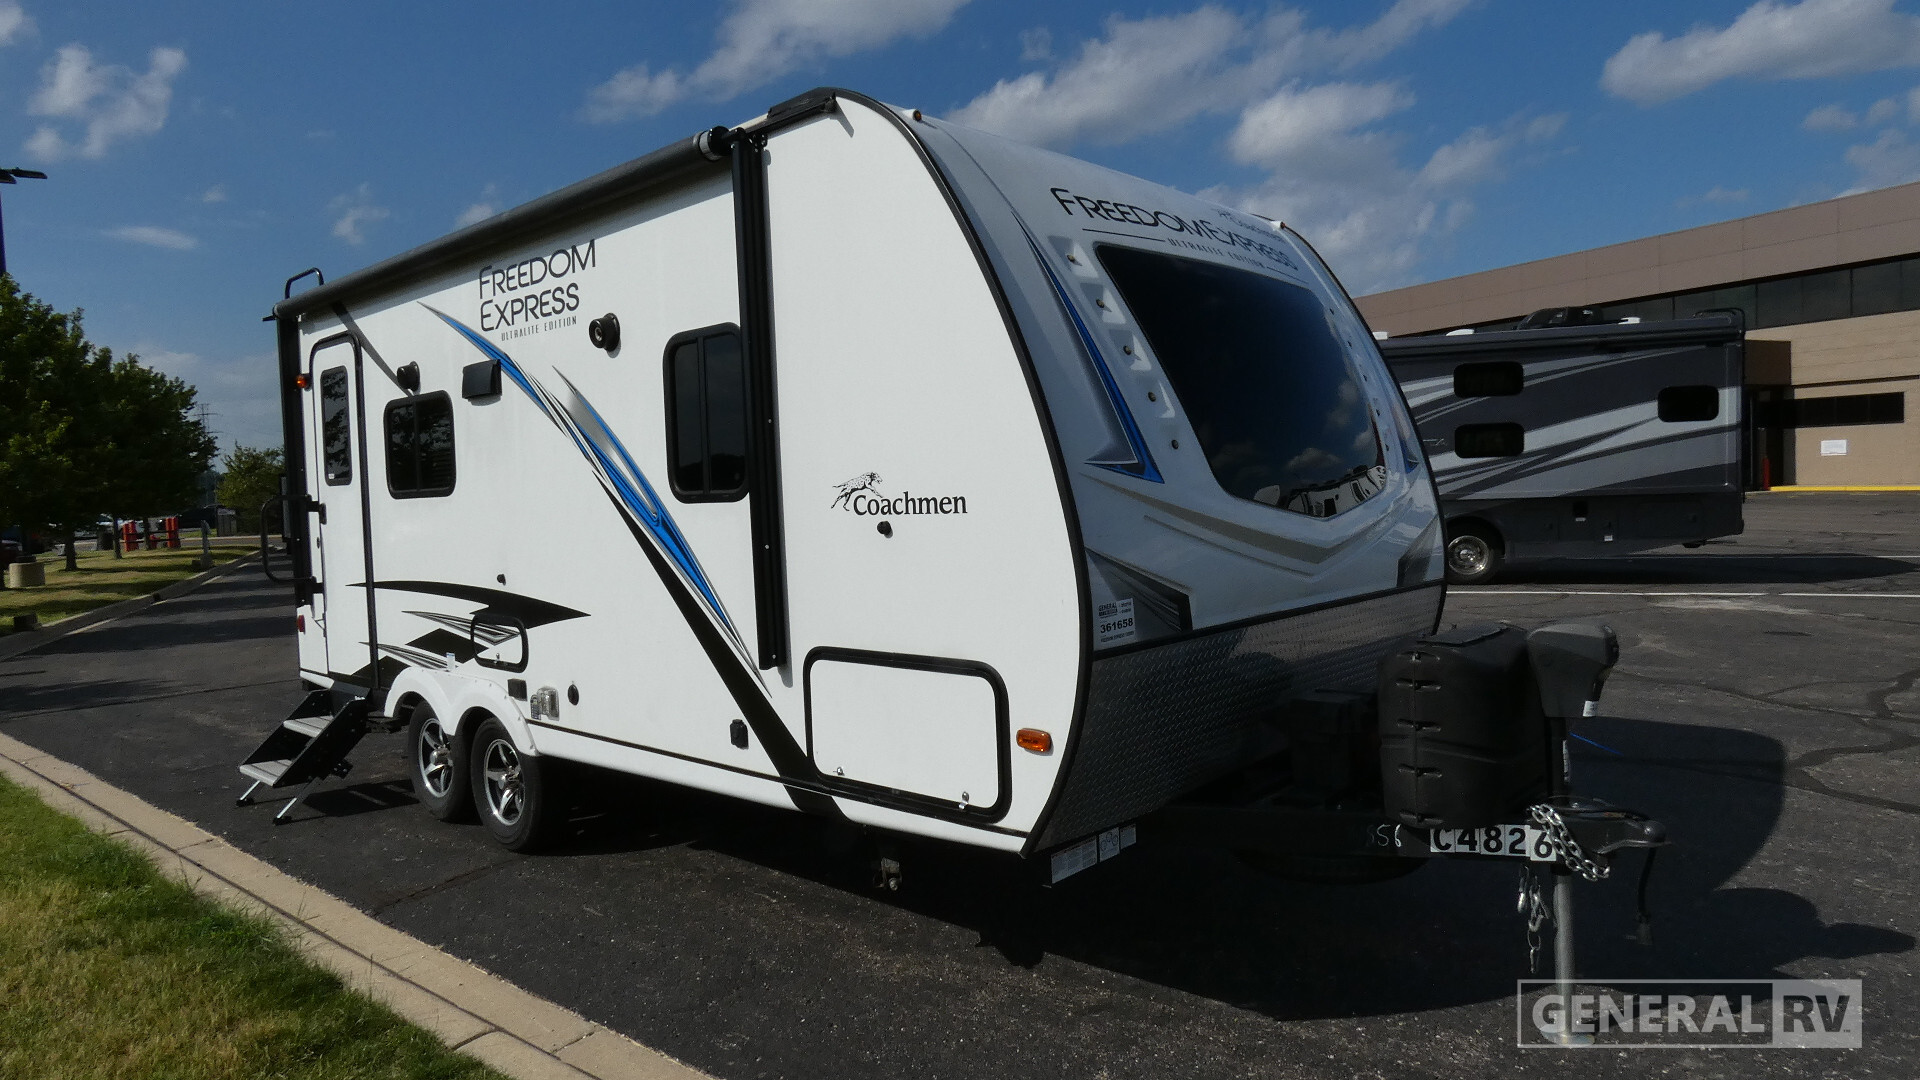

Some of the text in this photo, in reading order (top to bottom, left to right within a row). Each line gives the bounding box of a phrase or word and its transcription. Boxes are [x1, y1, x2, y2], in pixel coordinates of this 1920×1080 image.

[479, 239, 596, 299] FREEDOM
[480, 282, 580, 332] EXPRESS
[501, 316, 577, 342] ULTRALITE EDITION
[853, 491, 968, 516] Coachmen
[1100, 617, 1134, 633] 361658
[1432, 825, 1555, 859] C4826
